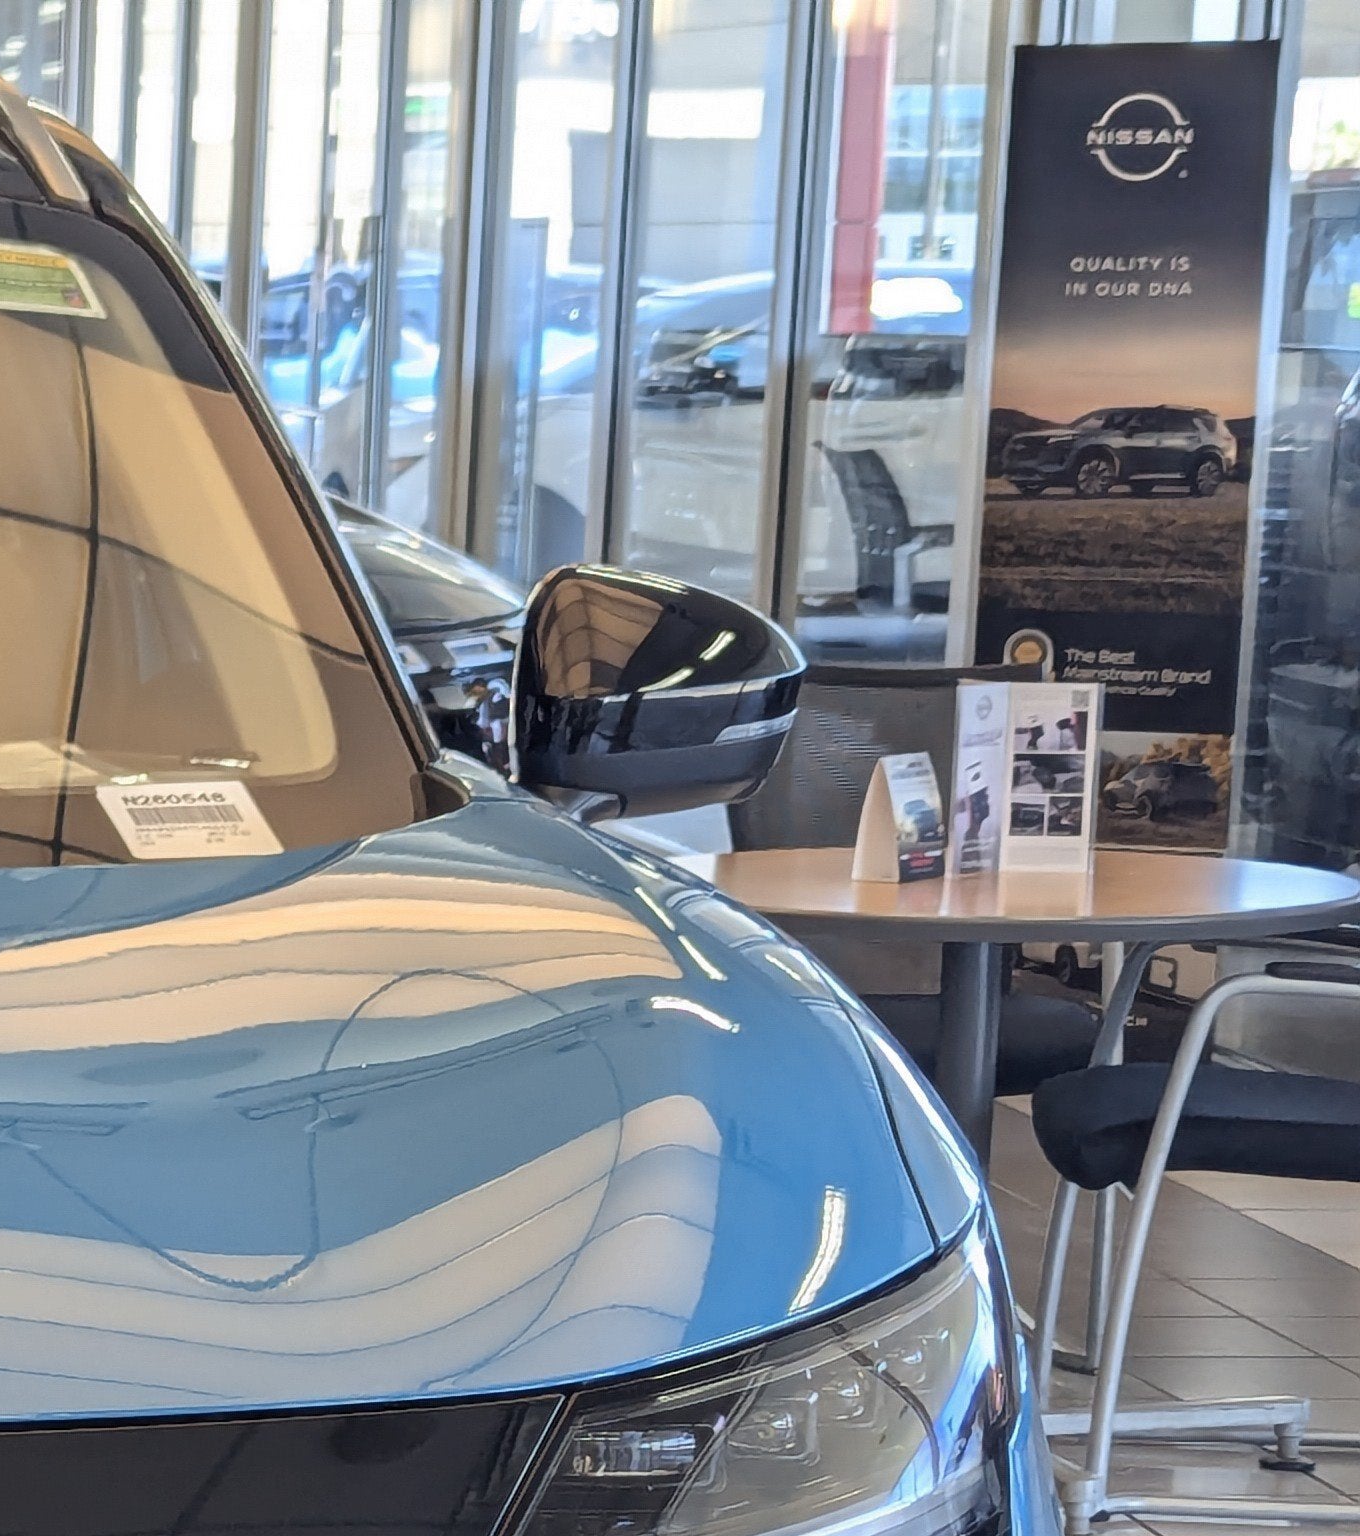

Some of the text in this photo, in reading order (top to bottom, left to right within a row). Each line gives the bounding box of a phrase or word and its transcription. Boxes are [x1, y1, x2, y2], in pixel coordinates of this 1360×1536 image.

[1086, 127, 1194, 145] NISSAN
[1069, 256, 1190, 272] QUALITY IS
[1065, 281, 1192, 297] IN OUR DNA
[1064, 648, 1096, 664] The
